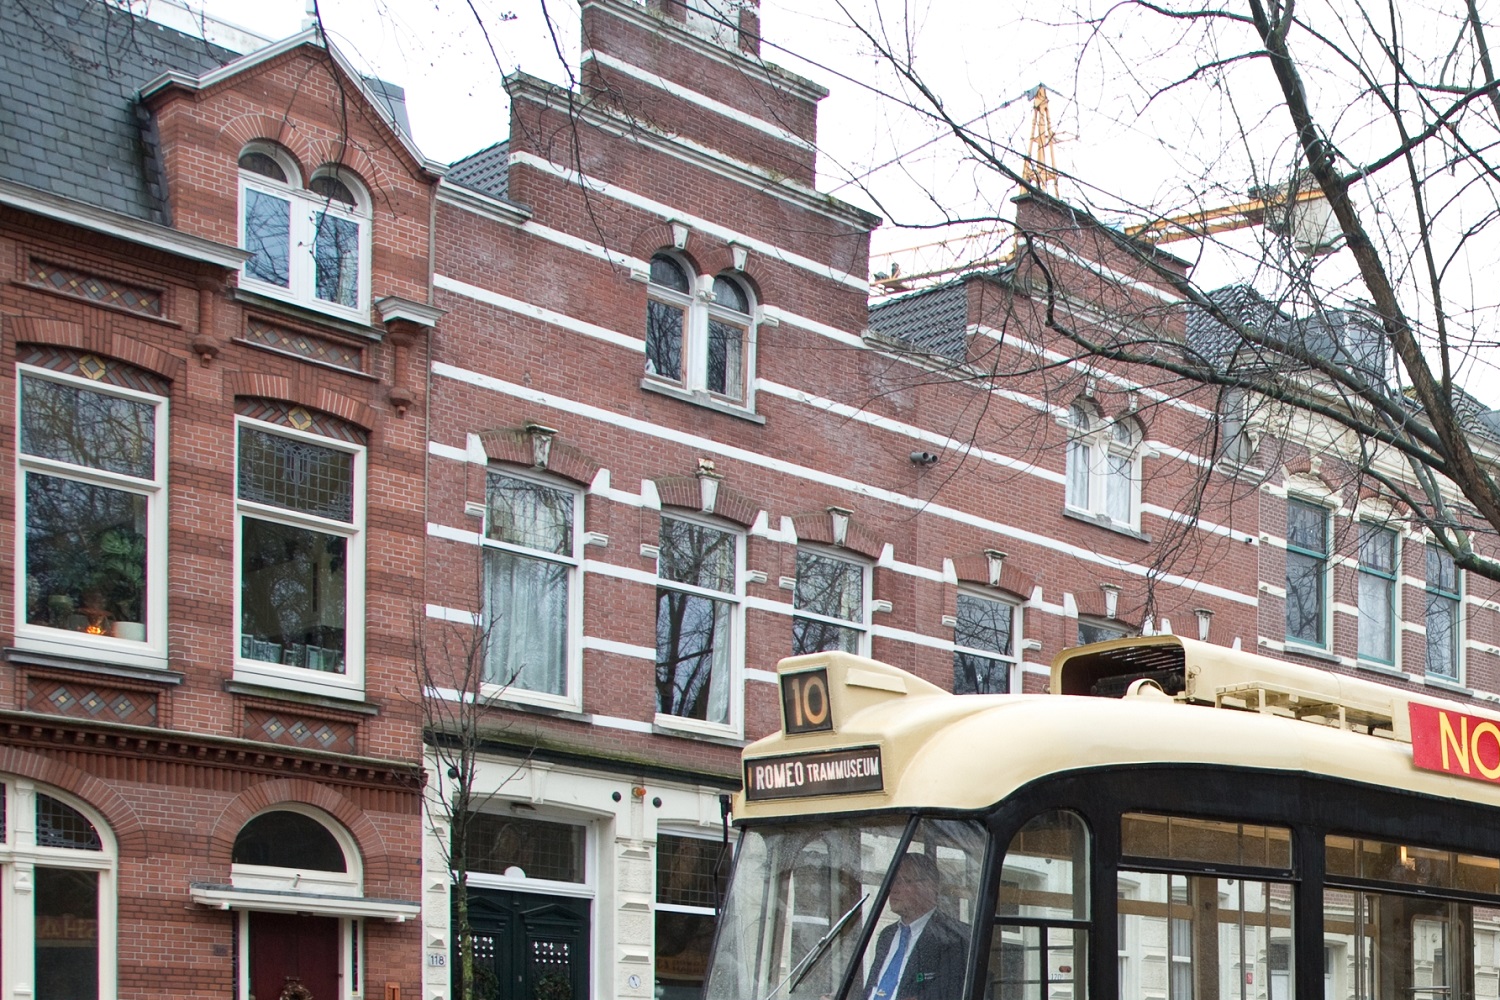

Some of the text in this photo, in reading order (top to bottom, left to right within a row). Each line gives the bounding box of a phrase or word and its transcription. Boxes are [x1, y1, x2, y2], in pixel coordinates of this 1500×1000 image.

[791, 675, 828, 727] 10
[755, 756, 879, 791] ROMEO TRAMMUSEUM
[430, 955, 445, 966] 118
